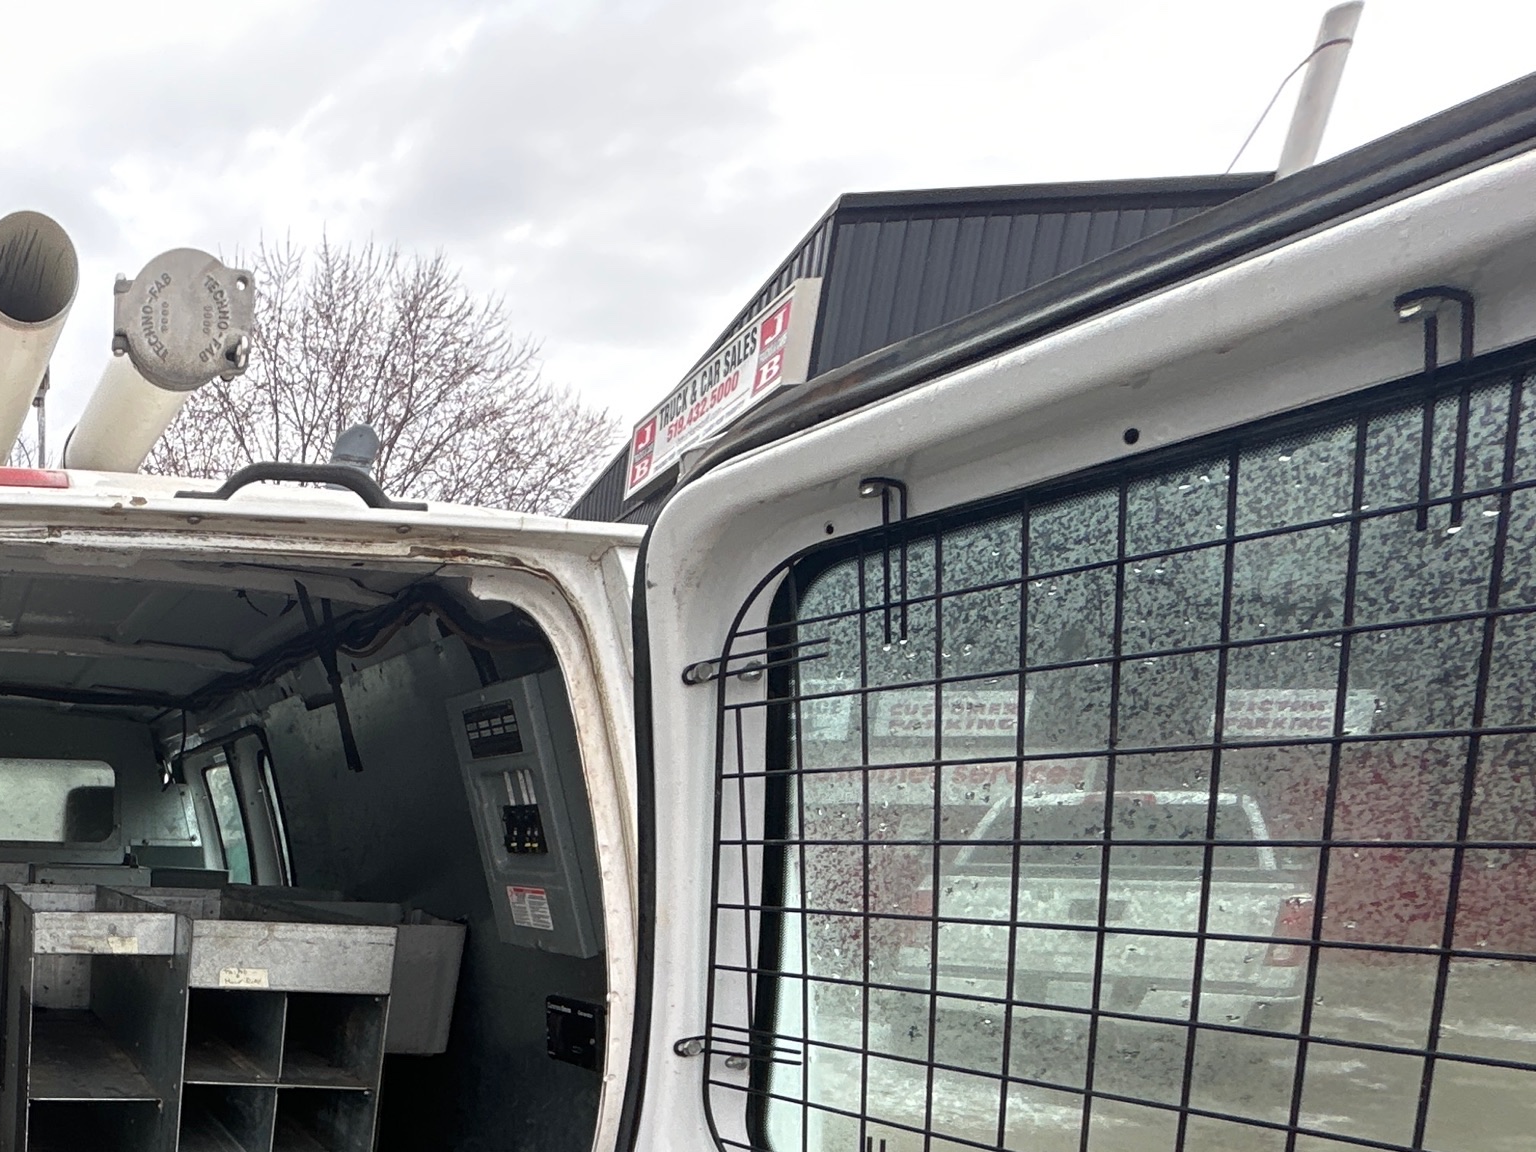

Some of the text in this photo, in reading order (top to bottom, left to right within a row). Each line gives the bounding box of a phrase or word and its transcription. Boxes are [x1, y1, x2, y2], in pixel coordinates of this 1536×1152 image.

[141, 272, 172, 363] TECHNO-FAB
[198, 274, 230, 363] TECHNO-FAB
[764, 307, 788, 345] J
[658, 379, 688, 431] TRUCK
[689, 379, 699, 403] &
[700, 358, 721, 397] CAR
[722, 326, 758, 378] SALES
[755, 353, 781, 391] B
[666, 370, 741, 443] 519.432.5000
[637, 422, 654, 450] J
[632, 457, 650, 484] B
